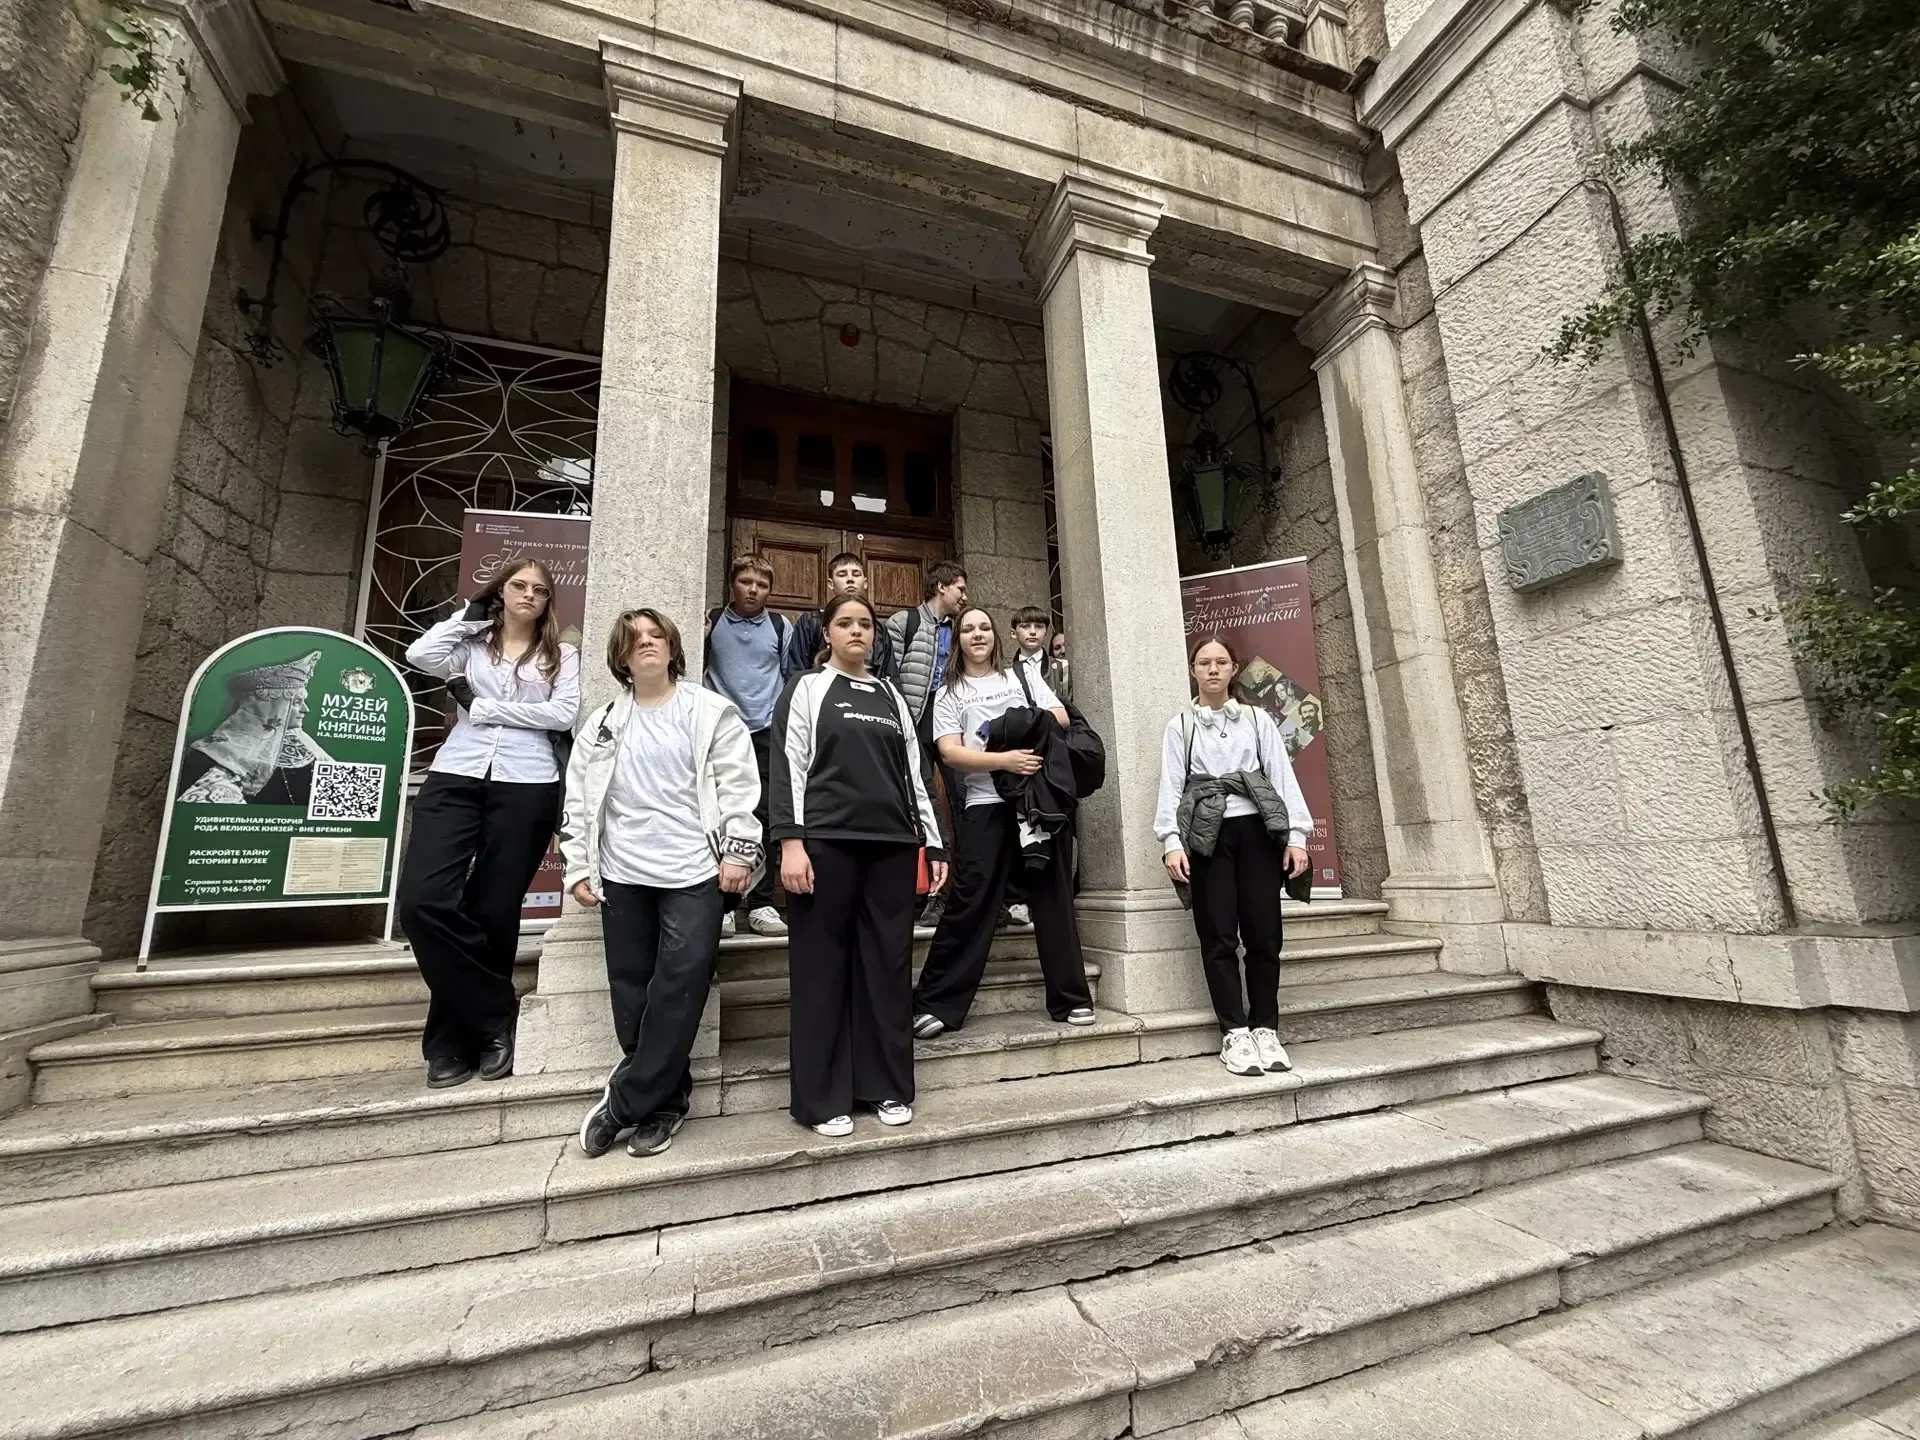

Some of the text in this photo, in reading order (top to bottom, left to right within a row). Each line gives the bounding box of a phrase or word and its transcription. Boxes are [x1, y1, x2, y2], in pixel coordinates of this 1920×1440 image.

[503, 539, 589, 551] Историко-культурны
[1195, 587, 1263, 603] Историко-культурный
[1265, 582, 1299, 593] фестиваль
[1194, 602, 1252, 621] Князья
[1184, 608, 1301, 636] Барятинские
[322, 693, 388, 713] МУЗЕЙ
[320, 707, 387, 723] УСАДЬБА
[318, 720, 387, 736] КНЯГИНИ
[333, 732, 386, 742] БАРЯТИНСКОЙ
[195, 816, 264, 824] УДИВИТЕЛЬНАЯ
[261, 825, 294, 833] КНЯЗЕЙ
[189, 848, 271, 856] РАСКРОЙТЕ ТАЙНУ
[184, 879, 221, 887] Справки
[234, 877, 272, 885] телефону
[196, 886, 220, 896] (978)
[221, 885, 266, 893] 946-59-01
